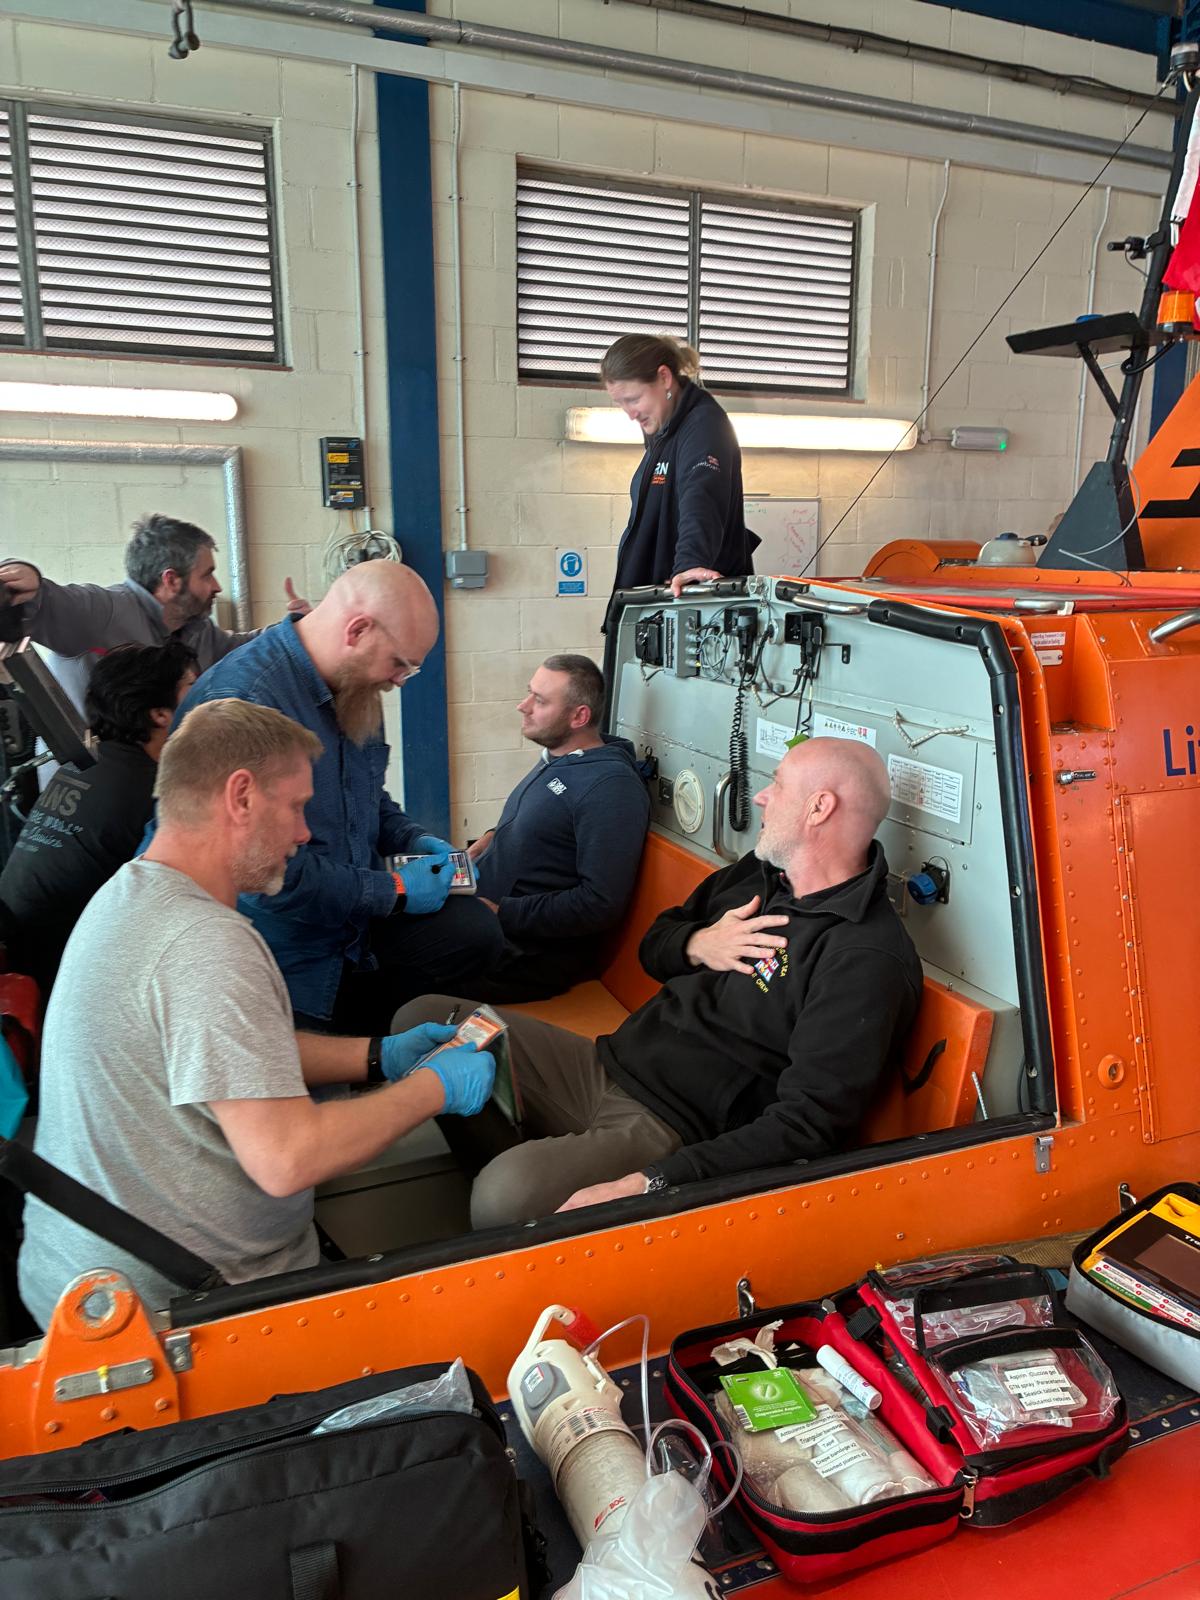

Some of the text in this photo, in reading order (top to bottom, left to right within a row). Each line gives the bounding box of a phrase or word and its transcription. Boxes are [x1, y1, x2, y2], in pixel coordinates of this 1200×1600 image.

[1163, 725, 1200, 776] Li
[1024, 1399, 1052, 1407] Salbutamol
[822, 1439, 835, 1449] Tape
[815, 1455, 830, 1465] Crepe
[830, 1445, 851, 1458] bandage
[821, 1462, 842, 1475] Assorted
[609, 1496, 625, 1509] BOC
